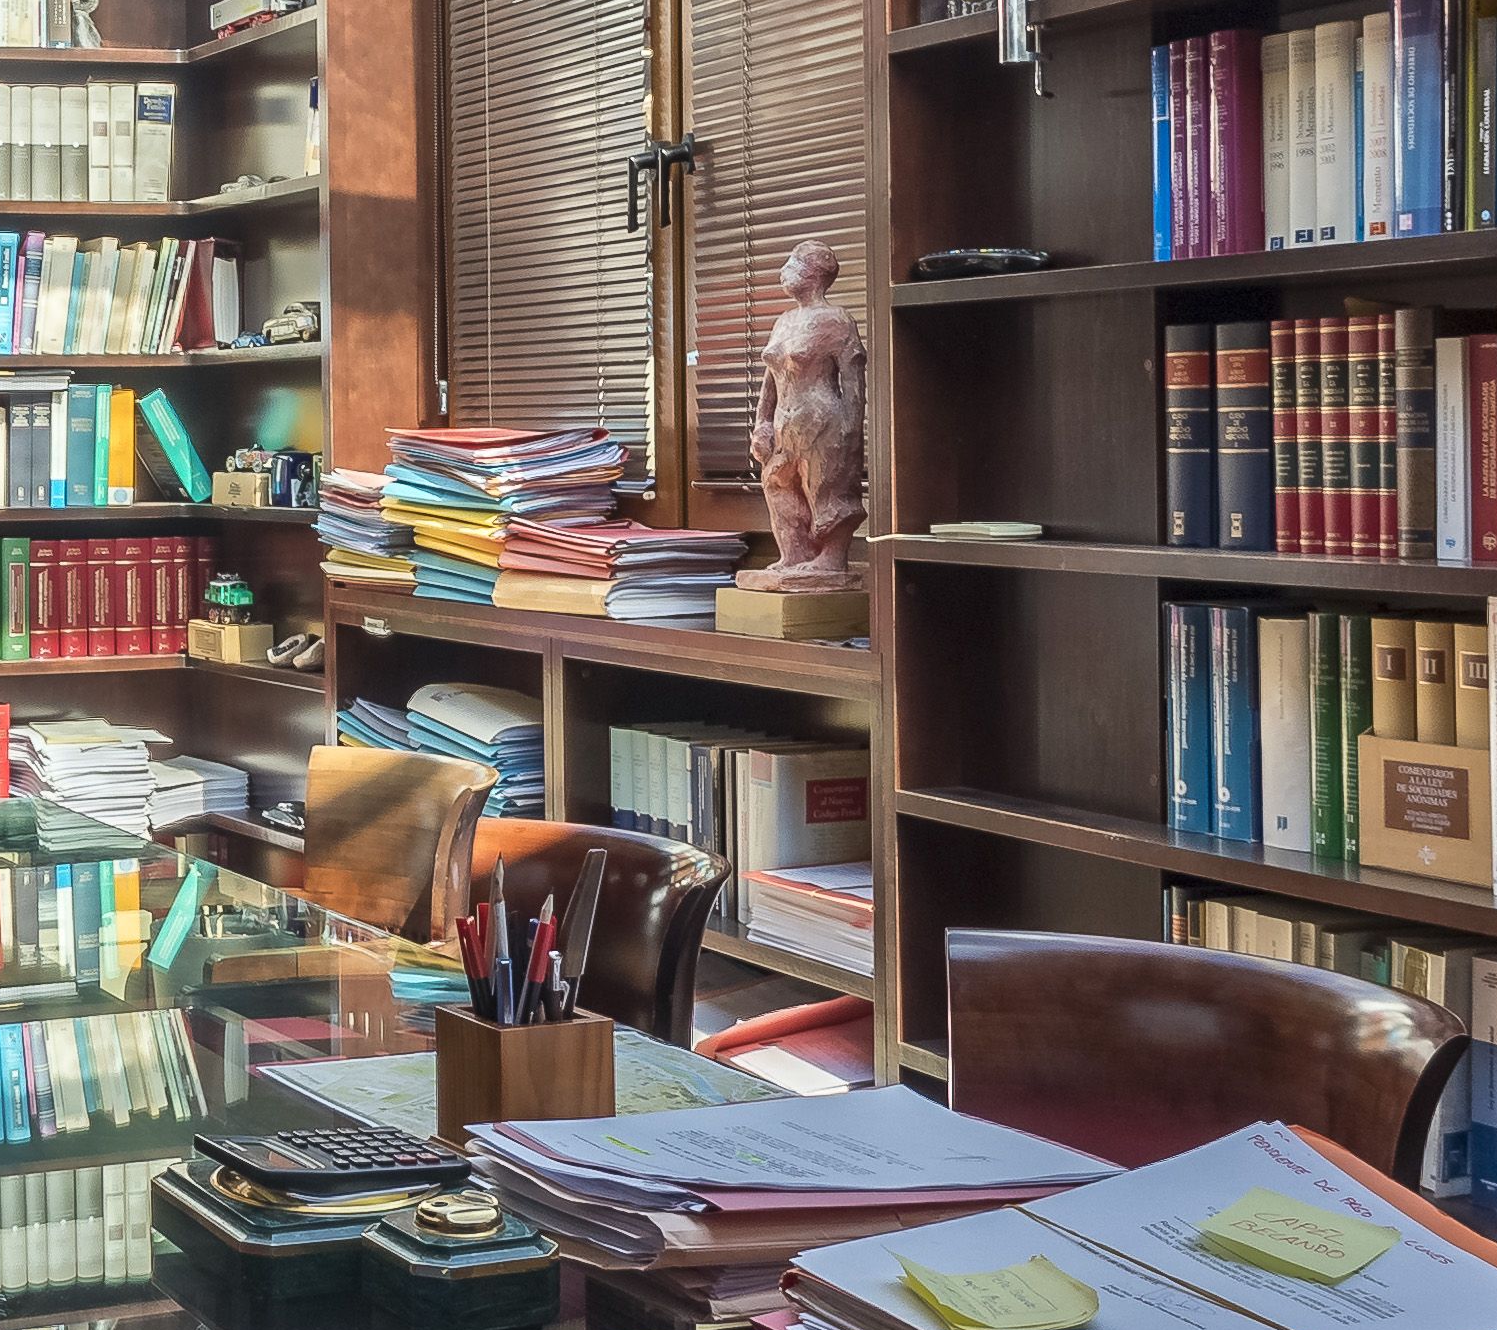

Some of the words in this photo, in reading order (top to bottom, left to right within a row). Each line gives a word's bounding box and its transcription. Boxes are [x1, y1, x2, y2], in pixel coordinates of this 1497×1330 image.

[1385, 654, 1393, 672] I
[1423, 657, 1437, 675] II
[1397, 765, 1455, 779] COMENTARIOS
[1396, 782, 1407, 793] DE
[1408, 784, 1458, 800] SOCIEDADES
[1416, 776, 1427, 786] LA
[1427, 777, 1444, 788] LEY
